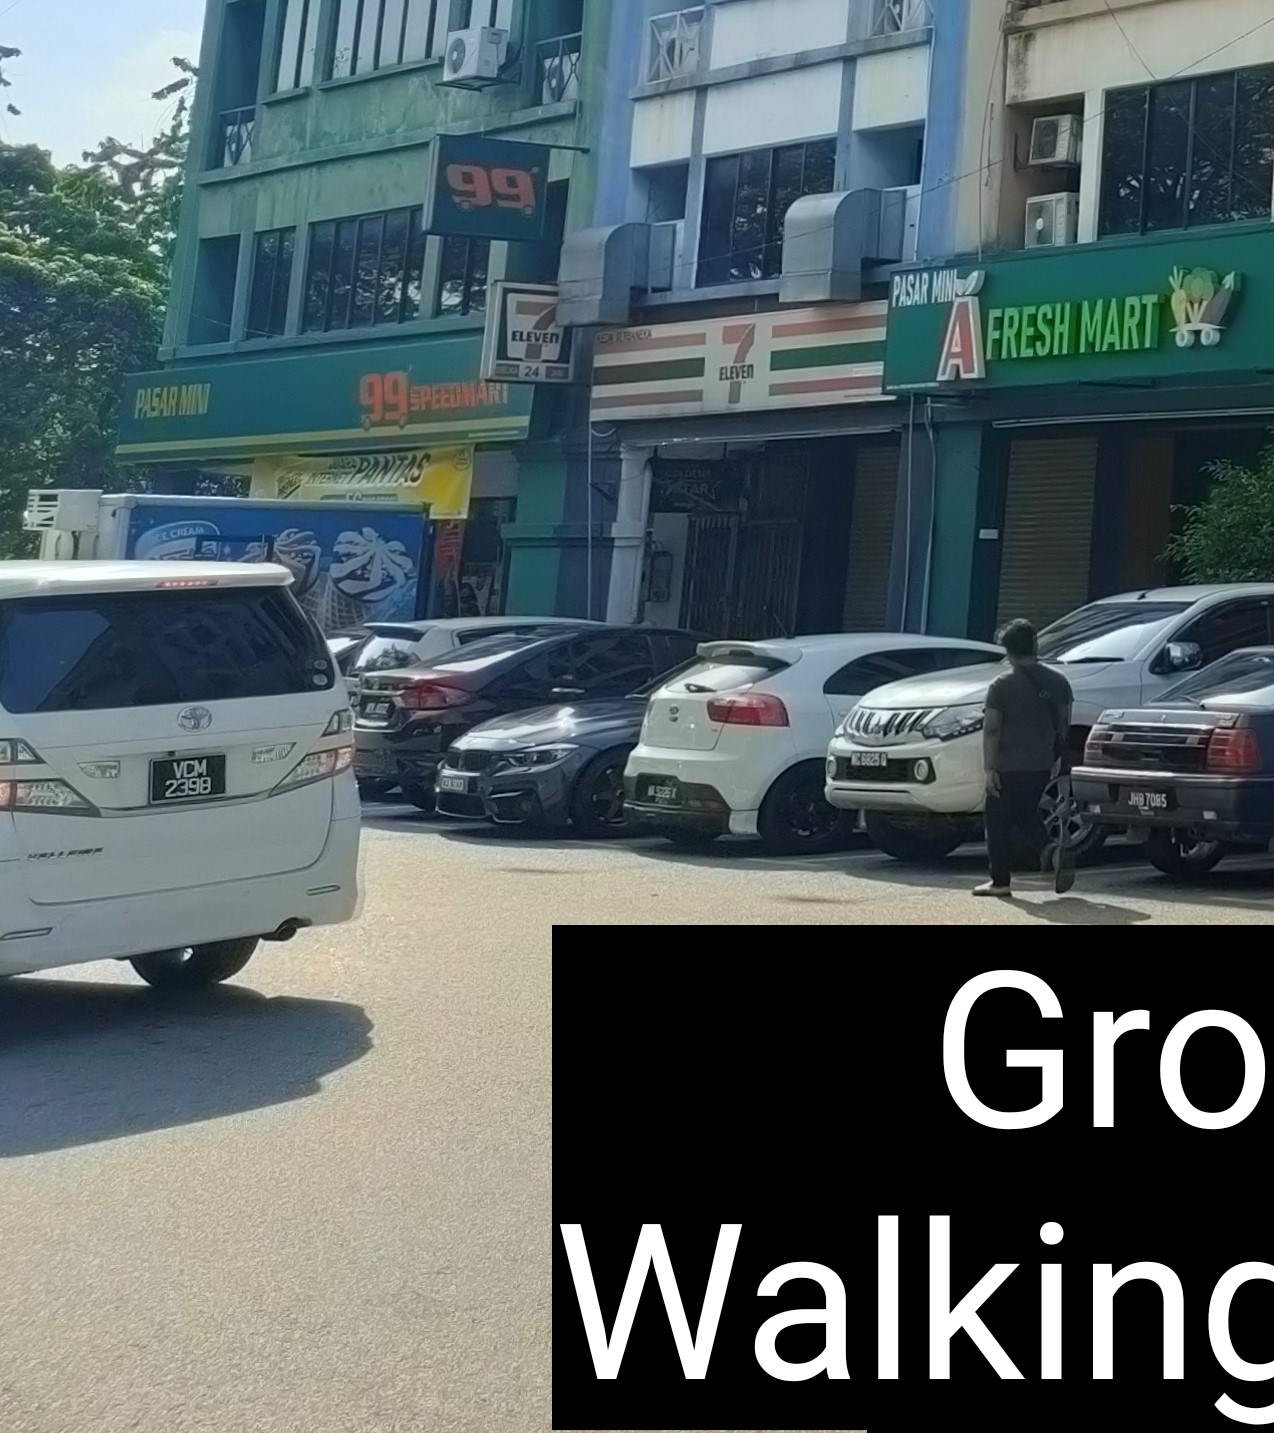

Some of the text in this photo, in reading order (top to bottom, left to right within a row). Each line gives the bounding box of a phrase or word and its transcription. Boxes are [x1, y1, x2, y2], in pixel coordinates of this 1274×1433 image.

[446, 163, 538, 216] 99
[892, 269, 957, 307] PASAR MINI
[511, 329, 560, 345] ELEVEN
[936, 291, 1160, 382] A FRESH MART
[523, 365, 540, 378] 24
[719, 363, 754, 382] ELEVEN
[133, 387, 178, 420] PASAR
[360, 370, 408, 428] 99
[351, 452, 432, 487] PANTAS
[173, 759, 207, 779] VCM
[165, 776, 212, 798] 2398
[1127, 791, 1168, 808] JHB 7085
